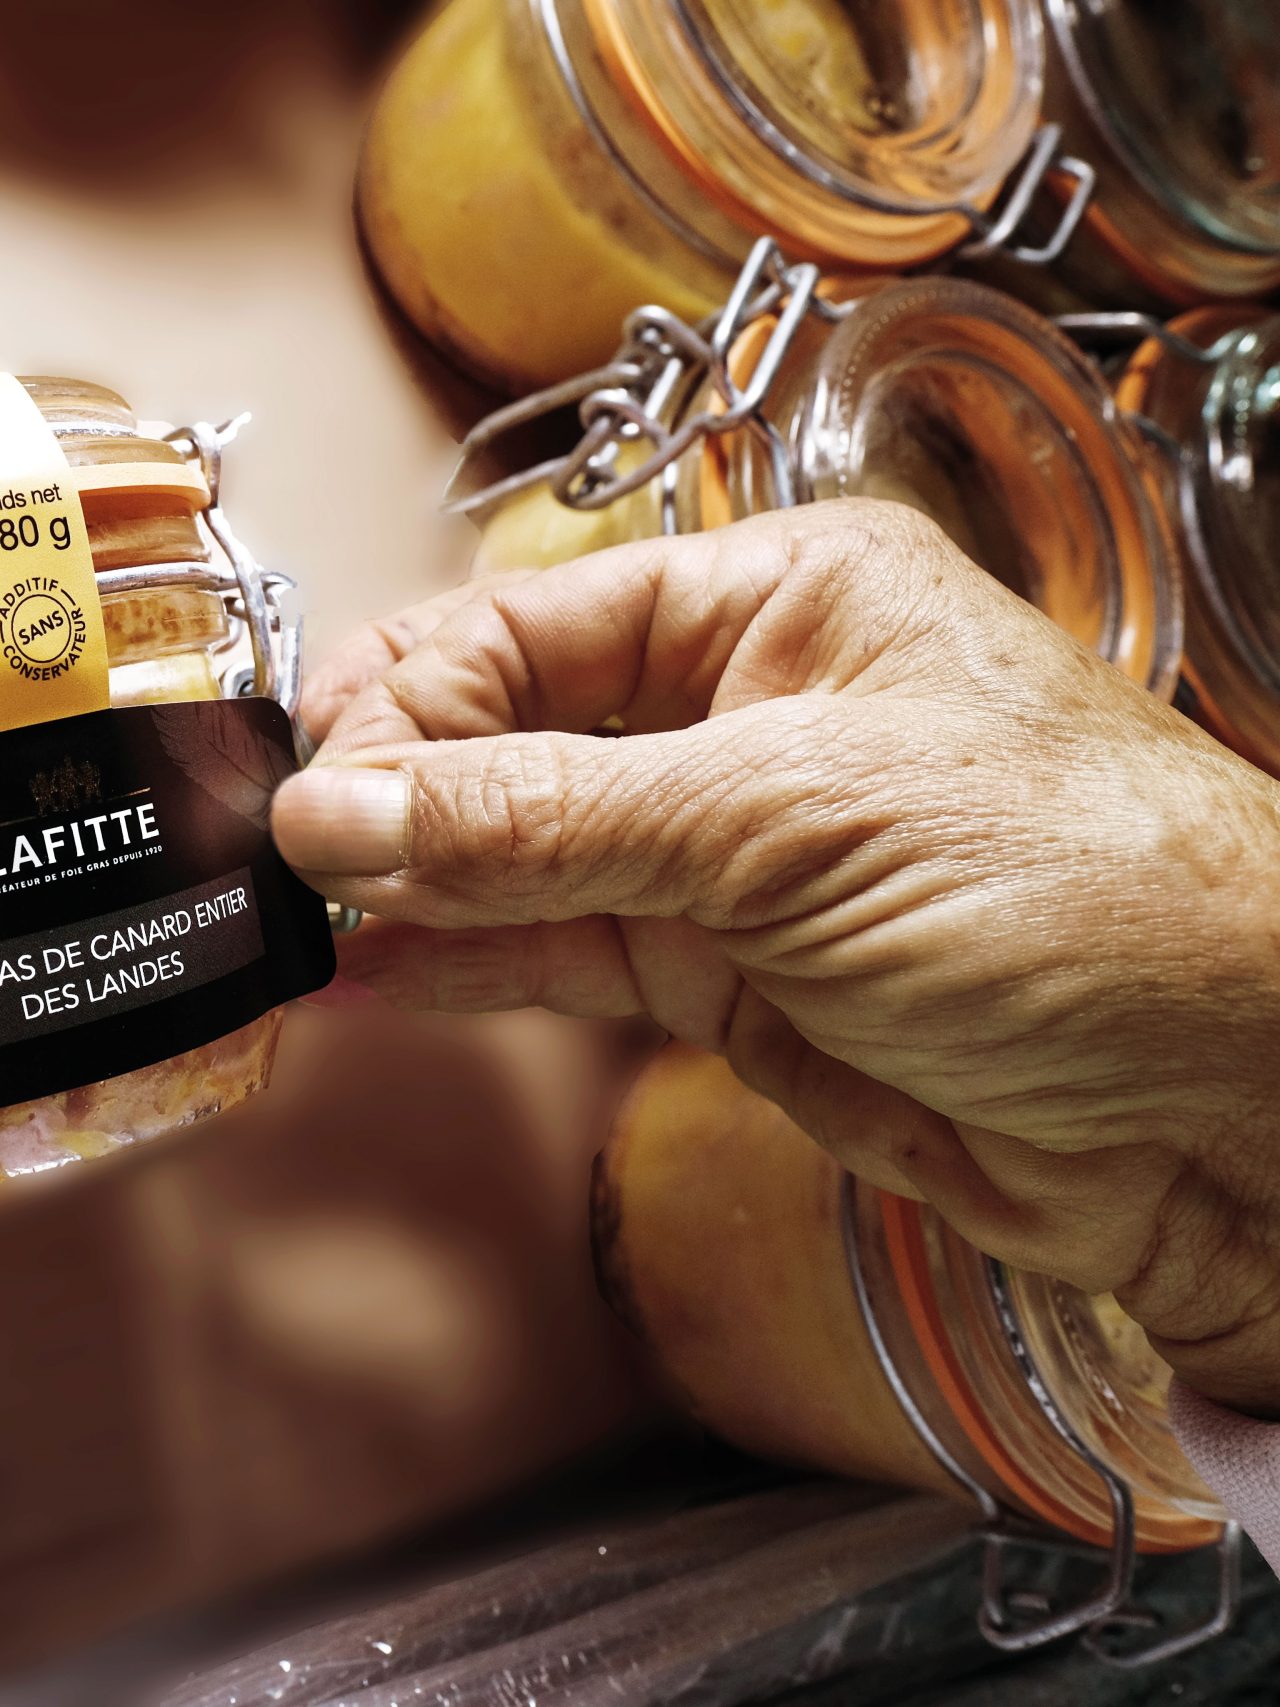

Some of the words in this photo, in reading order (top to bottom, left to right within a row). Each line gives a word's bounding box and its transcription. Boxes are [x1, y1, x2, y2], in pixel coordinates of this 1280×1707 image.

[31, 483, 62, 505] net
[49, 516, 71, 550] g
[3, 607, 86, 681] CONSERVATEUR
[19, 610, 64, 645] SANS
[44, 873, 57, 883] DE
[61, 867, 83, 879] FOIE
[86, 860, 110, 872] GRAS
[113, 851, 142, 865] DEPUIS
[145, 845, 163, 856] 1920
[43, 941, 85, 974] DE
[90, 910, 192, 961] CANARD
[195, 887, 248, 928] ENTIER
[21, 983, 80, 1020] DES
[86, 951, 185, 1003] LANDES
